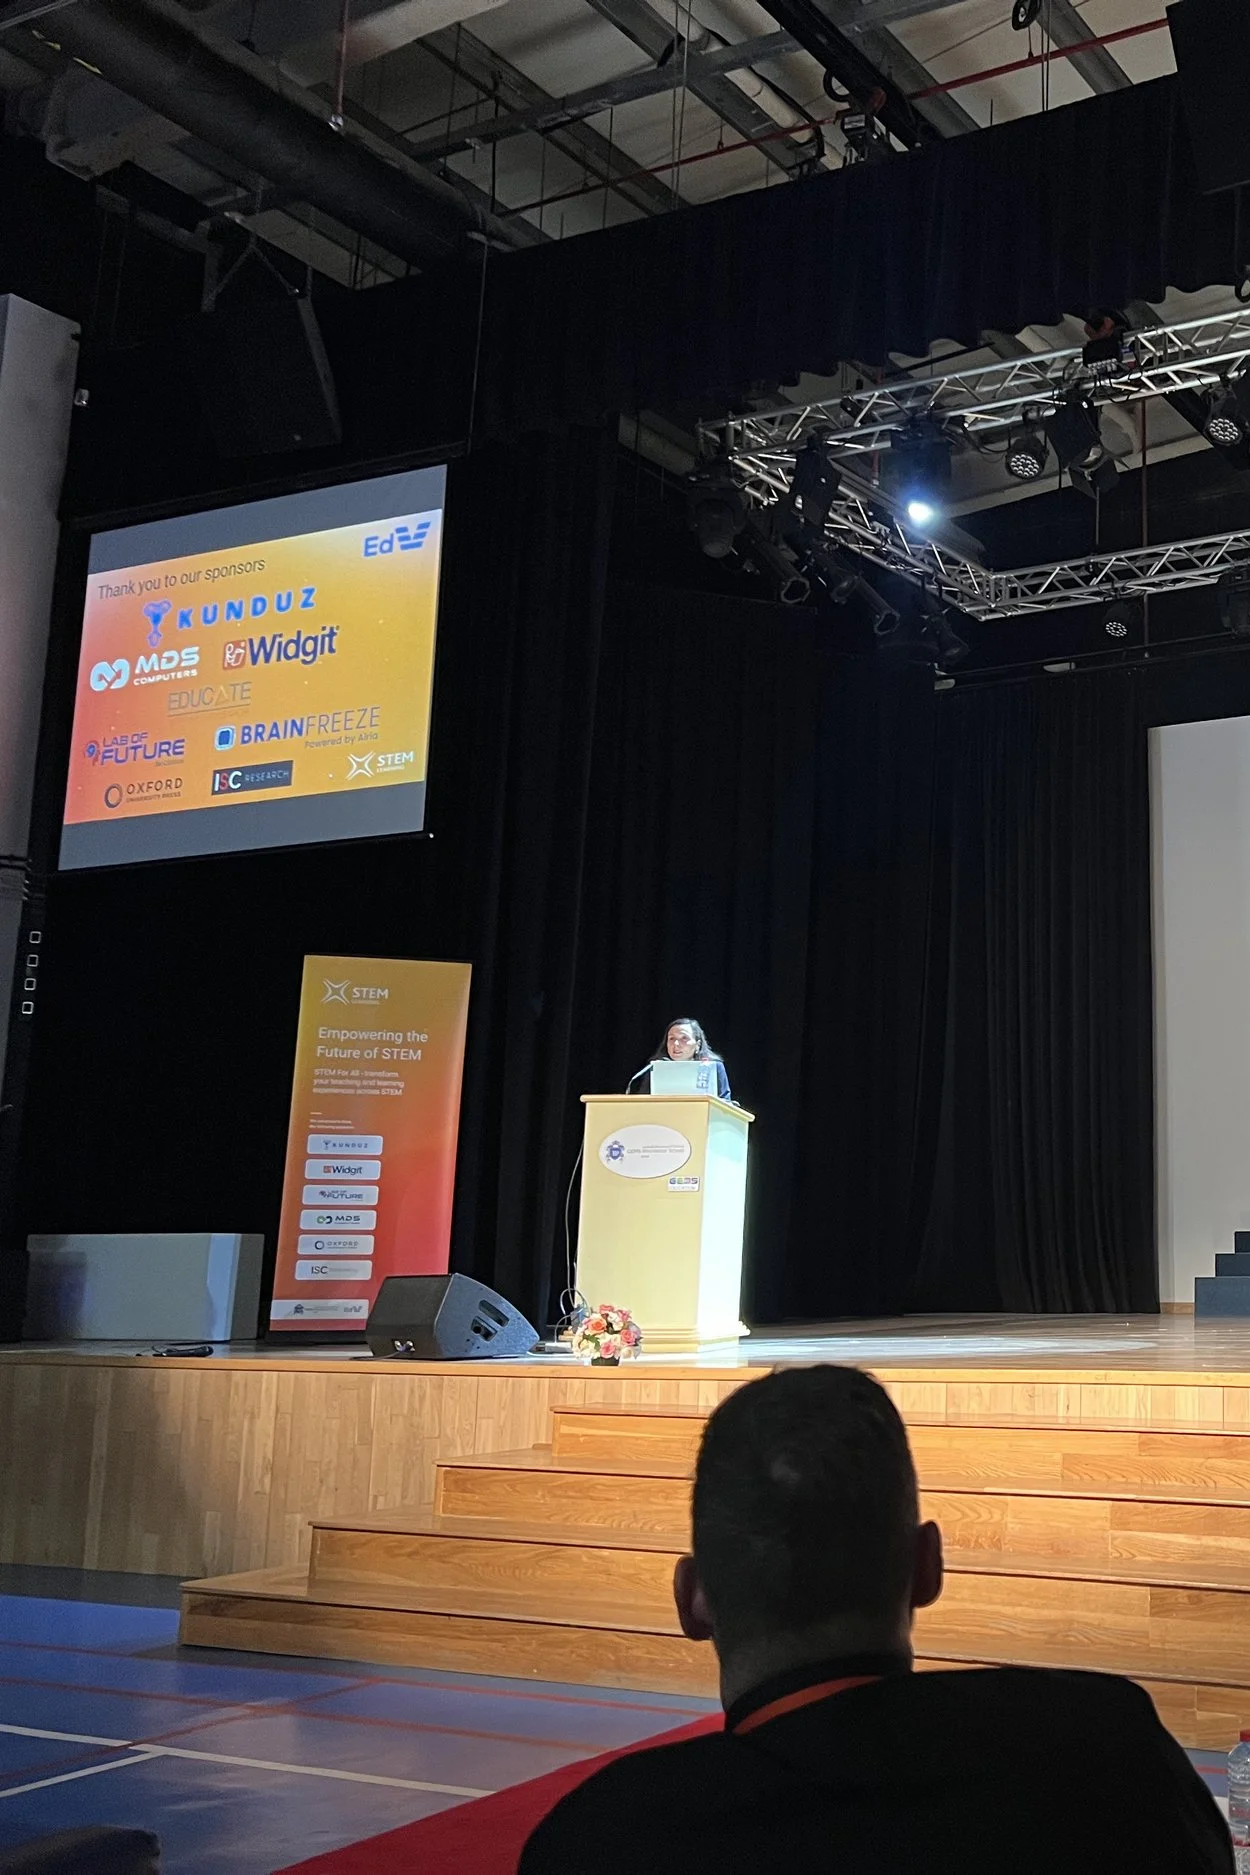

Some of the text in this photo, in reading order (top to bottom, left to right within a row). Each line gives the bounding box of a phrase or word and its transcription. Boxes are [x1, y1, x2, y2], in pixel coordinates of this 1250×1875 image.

[98, 559, 266, 599] Thank you to our sponsors
[177, 586, 316, 629] KUNDUZ
[248, 626, 339, 666] Widgit
[134, 646, 200, 674] MDS
[133, 668, 198, 686] COMPUTERS
[168, 682, 252, 711] EDUCATE
[240, 706, 381, 745] BRAINFREEZE
[103, 732, 148, 747] LAB OF
[344, 735, 356, 745] by
[101, 739, 185, 765] FUTURE
[377, 751, 414, 766] STEM
[126, 777, 183, 794] OXFORD
[214, 770, 289, 791] ISC RESEARCH
[352, 987, 389, 999] STEM
[318, 1027, 428, 1044] Empowering the
[316, 1046, 422, 1060] Future of STEM
[311, 1266, 328, 1274] ISC
